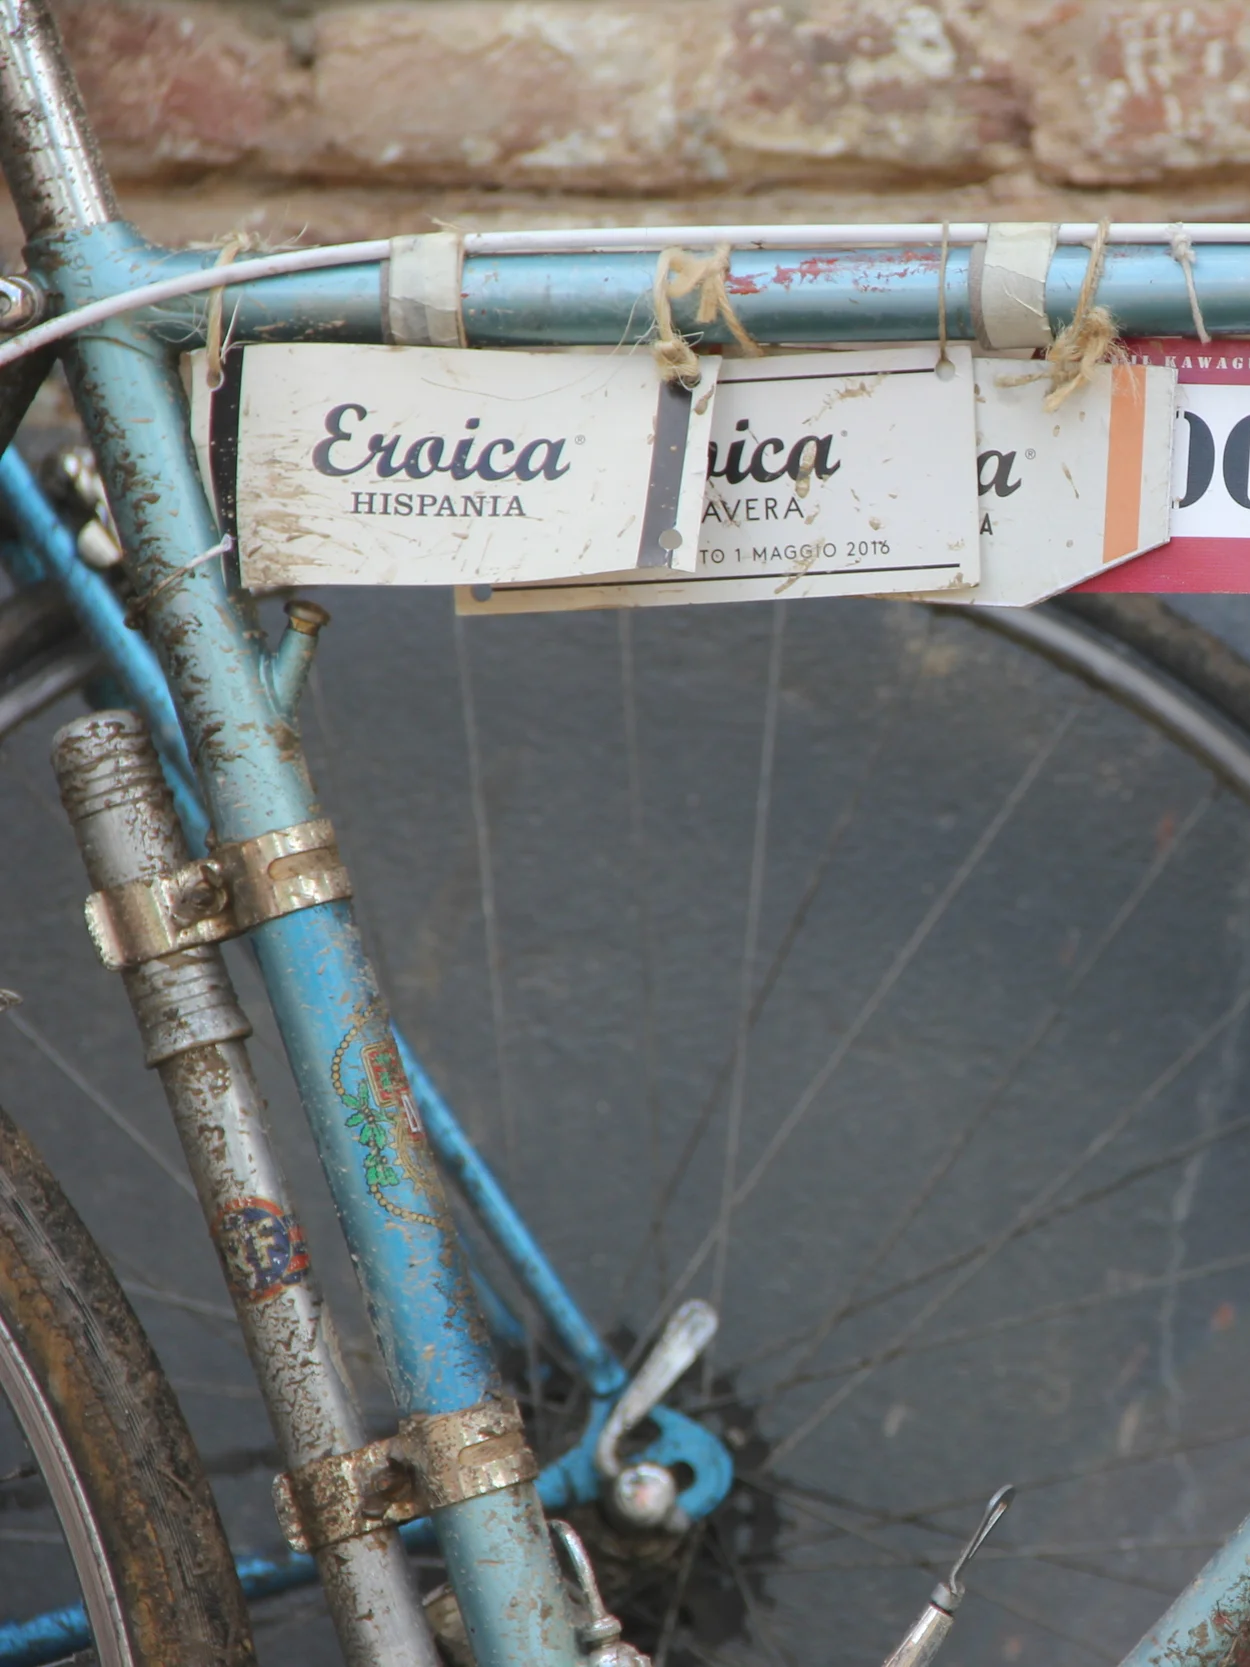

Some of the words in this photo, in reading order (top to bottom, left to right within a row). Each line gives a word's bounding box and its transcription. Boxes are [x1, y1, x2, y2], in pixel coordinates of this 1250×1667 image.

[311, 403, 571, 482] Eroica
[350, 490, 527, 518] HISPANIA
[735, 548, 742, 562] 1
[752, 542, 837, 562] MAGGIO
